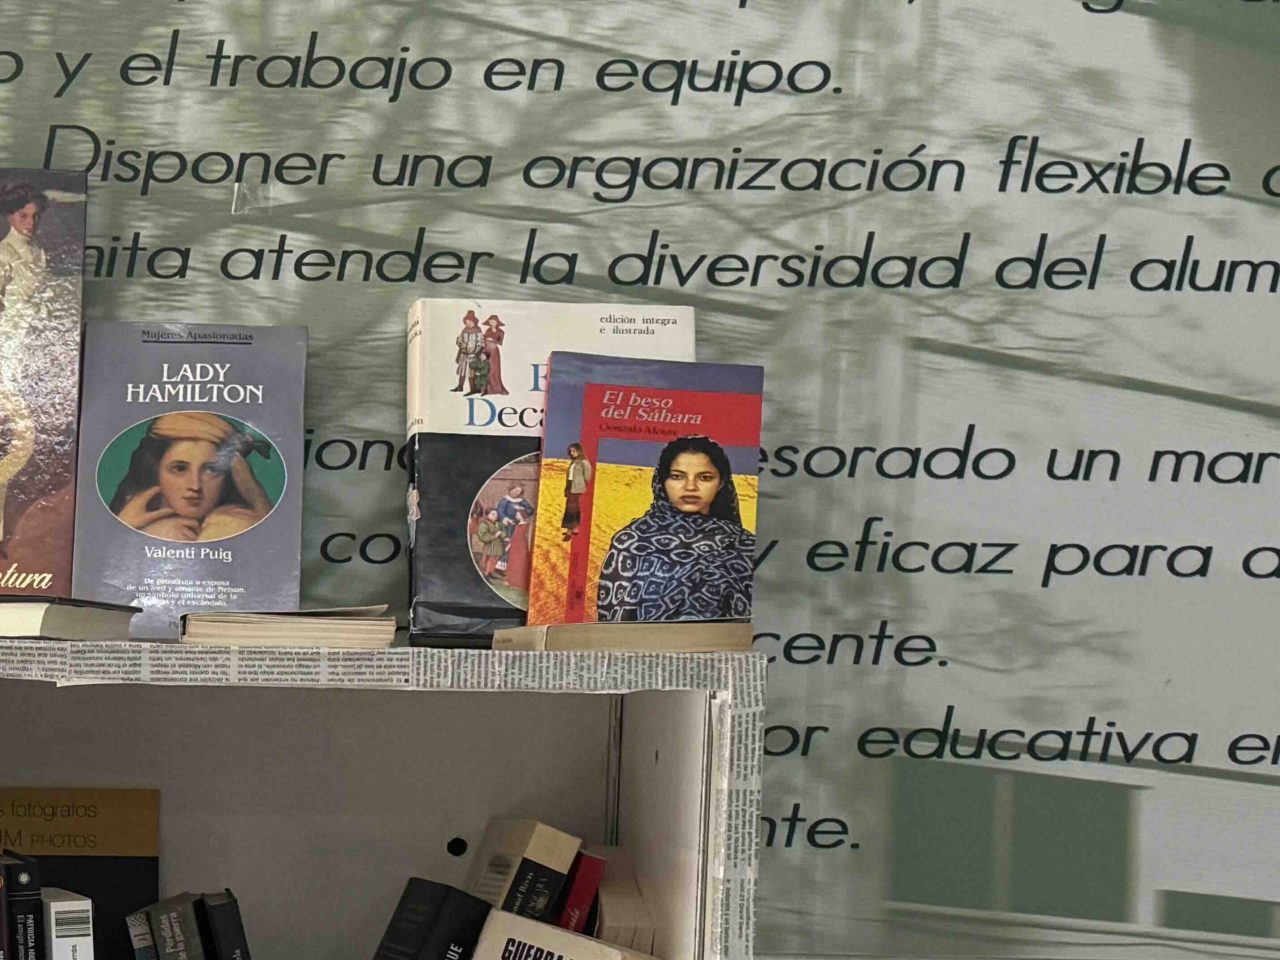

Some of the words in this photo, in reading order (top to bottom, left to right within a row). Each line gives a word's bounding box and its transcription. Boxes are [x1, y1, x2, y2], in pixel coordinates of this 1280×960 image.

[53, 51, 94, 98] y
[119, 28, 181, 88] el
[205, 30, 454, 103] trabajo
[482, 56, 566, 93] en
[594, 48, 844, 106] equipo.
[42, 123, 346, 196] Disponer
[371, 152, 493, 190] una
[522, 143, 967, 205] organización
[997, 134, 1232, 197] flexible
[220, 226, 494, 284] atender
[519, 227, 579, 287] la
[607, 229, 972, 289] diversidad
[994, 232, 1107, 291] del
[611, 325, 656, 336] ilustrada
[162, 363, 232, 382] LADY
[125, 383, 264, 404] HAMILTON
[602, 390, 625, 406] El
[628, 392, 674, 409] beso
[600, 405, 632, 420] del
[1045, 447, 1121, 483] un
[200, 547, 233, 562] Puig
[805, 516, 1020, 575] eficaz
[1040, 542, 1214, 589] para
[856, 704, 1199, 765] educativa
[30, 833, 98, 849] PHOTOS
[26, 914, 36, 947] PATRICIA
